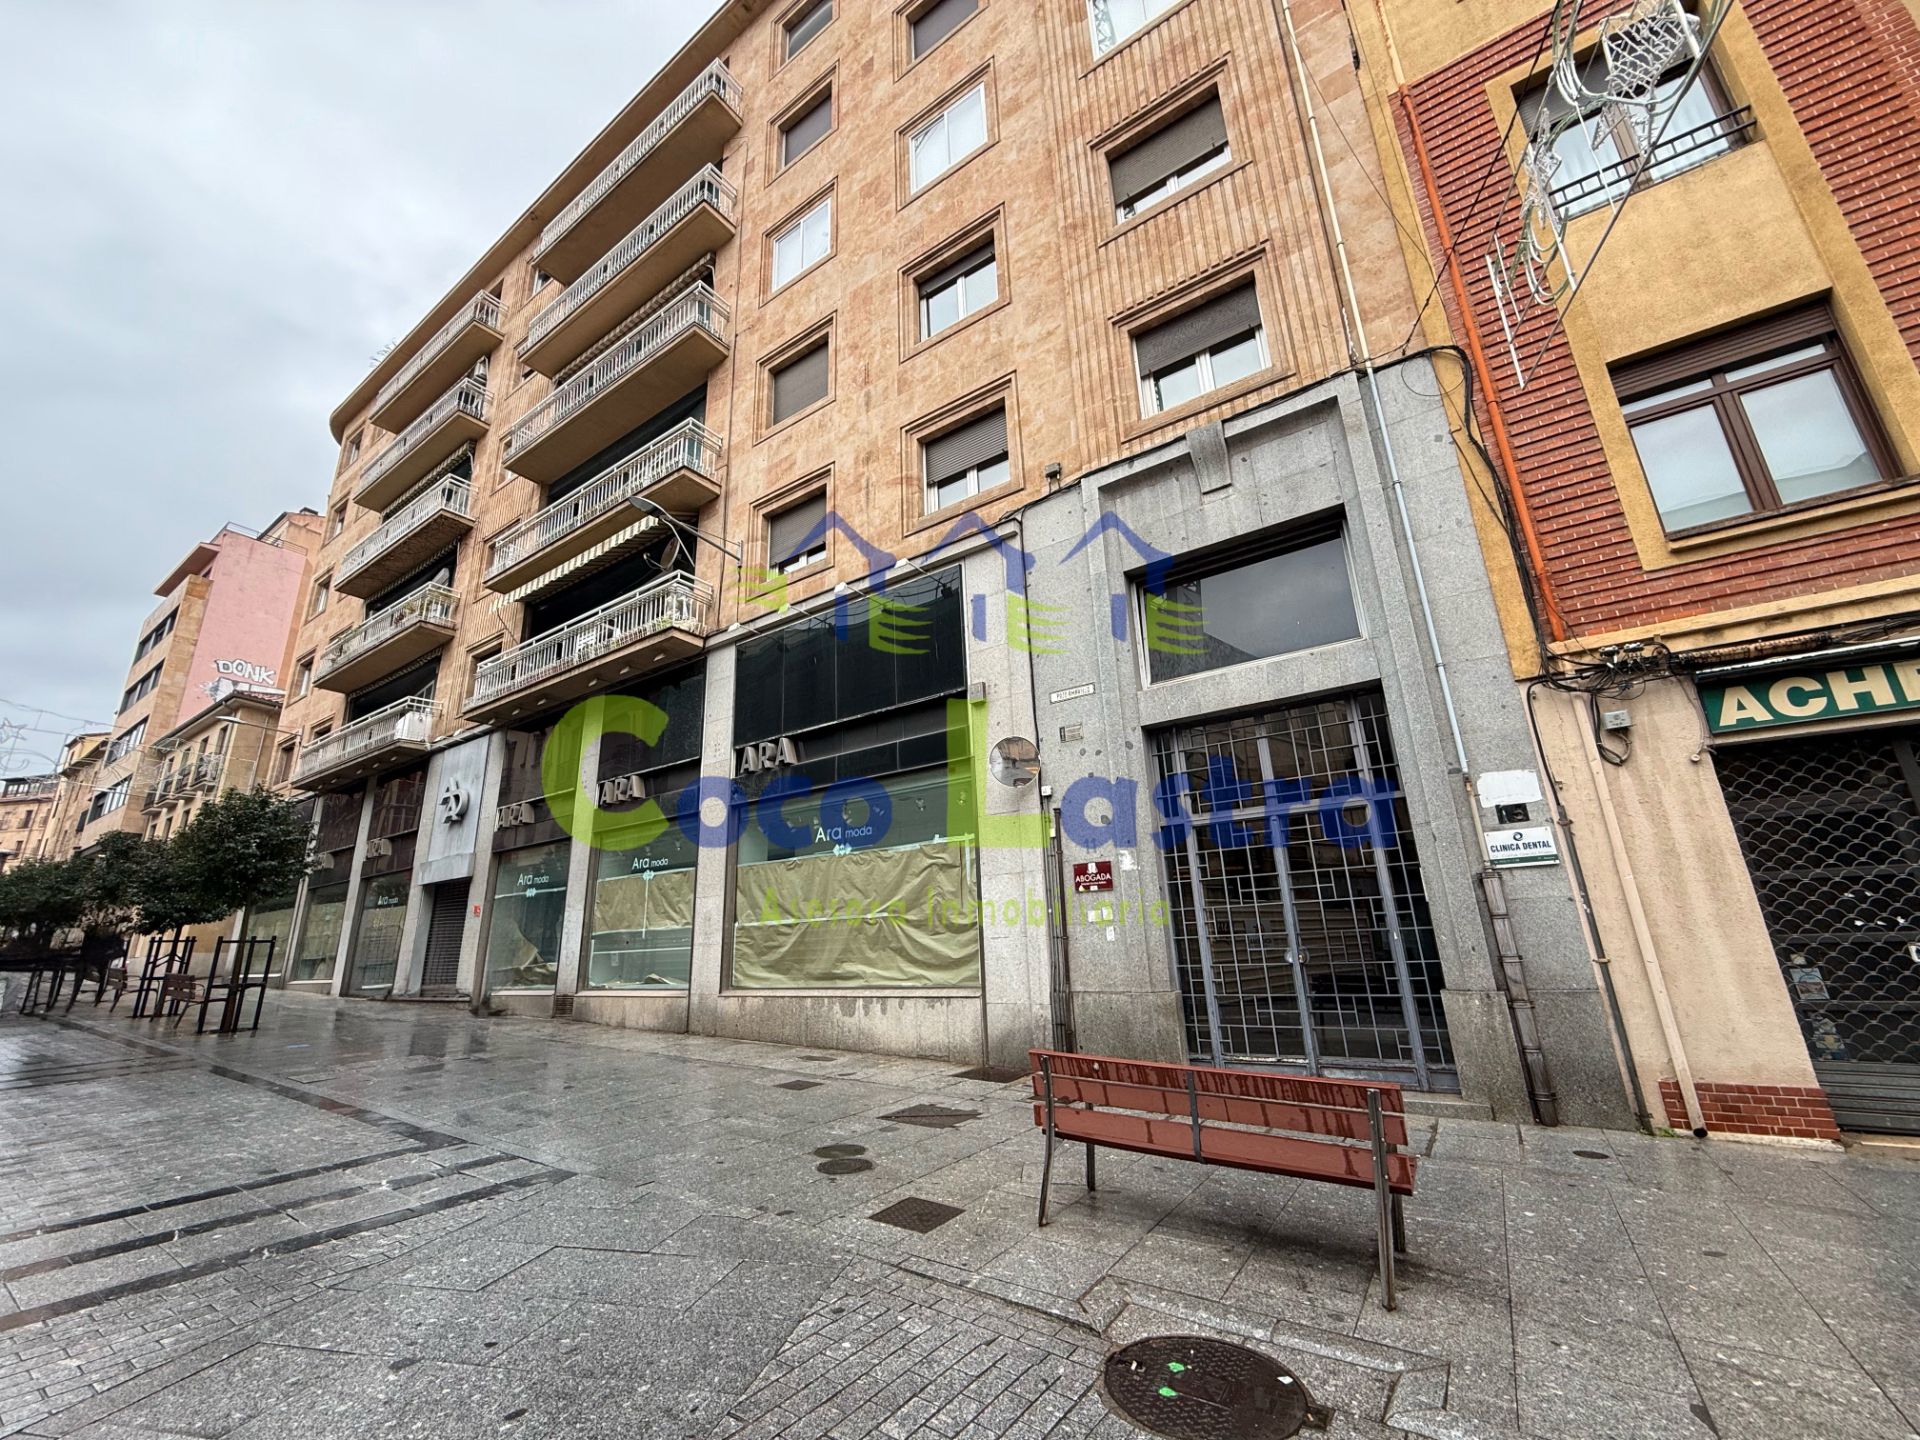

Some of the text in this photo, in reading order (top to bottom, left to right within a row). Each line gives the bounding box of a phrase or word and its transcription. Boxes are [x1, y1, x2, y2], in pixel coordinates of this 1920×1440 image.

[214, 658, 275, 685] DONK
[740, 737, 798, 774] ARA
[600, 775, 646, 804] ARA
[499, 803, 535, 828] ARA
[815, 826, 873, 843] Ara moda
[1490, 840, 1552, 853] CLINICA DENTAL
[631, 857, 669, 870] Ara moda
[517, 873, 533, 887] Ara
[1075, 872, 1112, 883] ABOGADA
